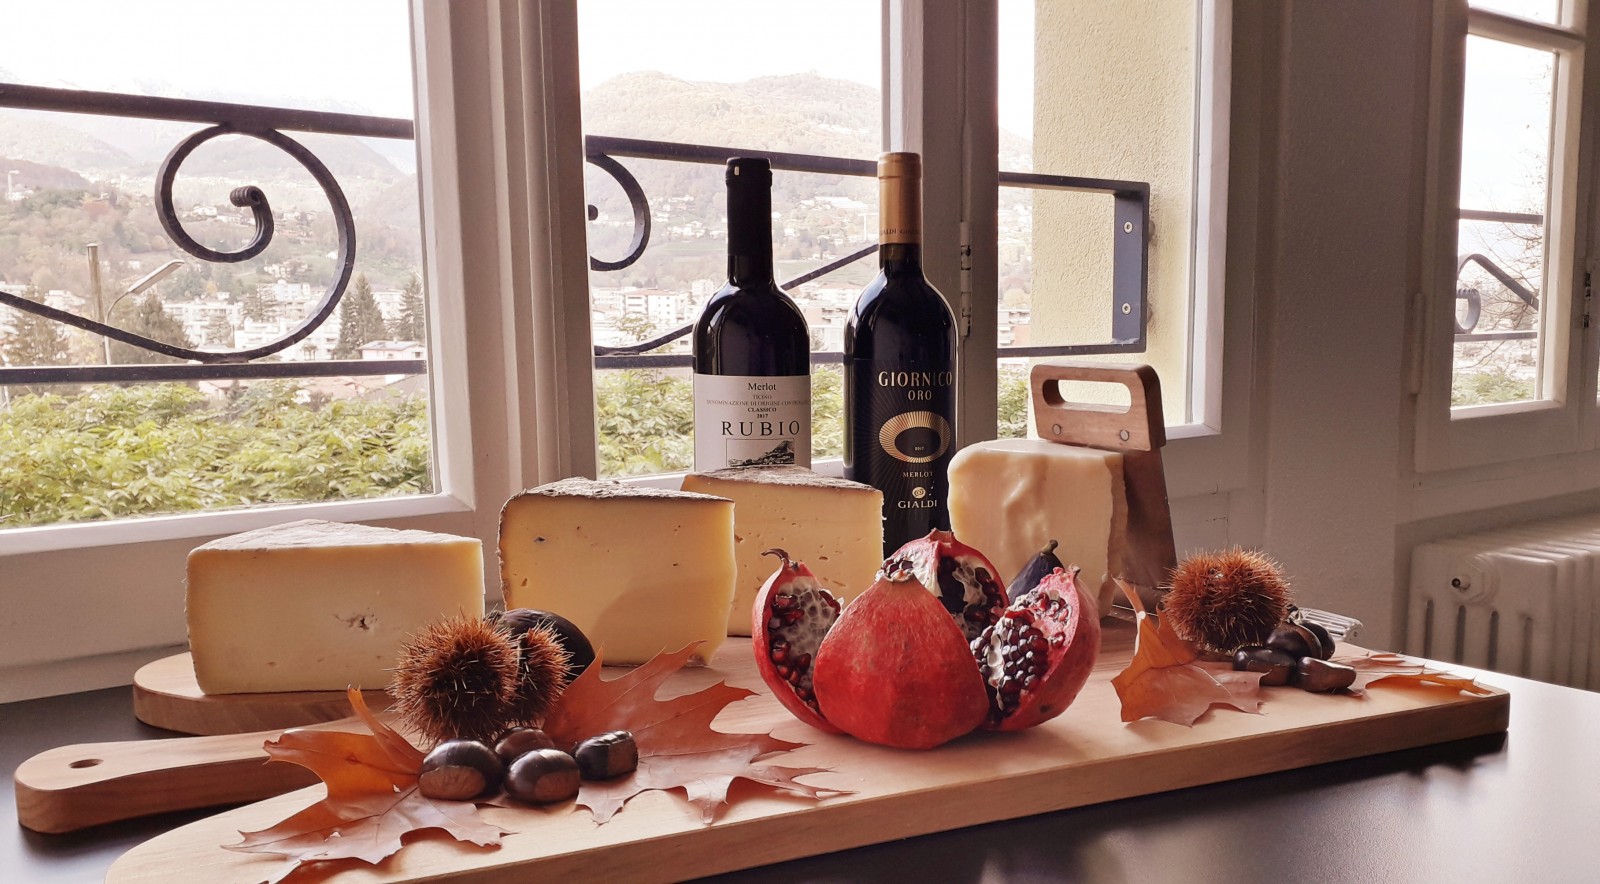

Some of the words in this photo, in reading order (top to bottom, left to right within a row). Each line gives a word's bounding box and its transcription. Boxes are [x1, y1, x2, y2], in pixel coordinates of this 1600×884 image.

[878, 370, 953, 387] GIORNICO
[747, 382, 777, 391] Merlot
[908, 389, 932, 401] ORO
[721, 420, 800, 437] RUBIO
[897, 499, 938, 509] GIALDI
